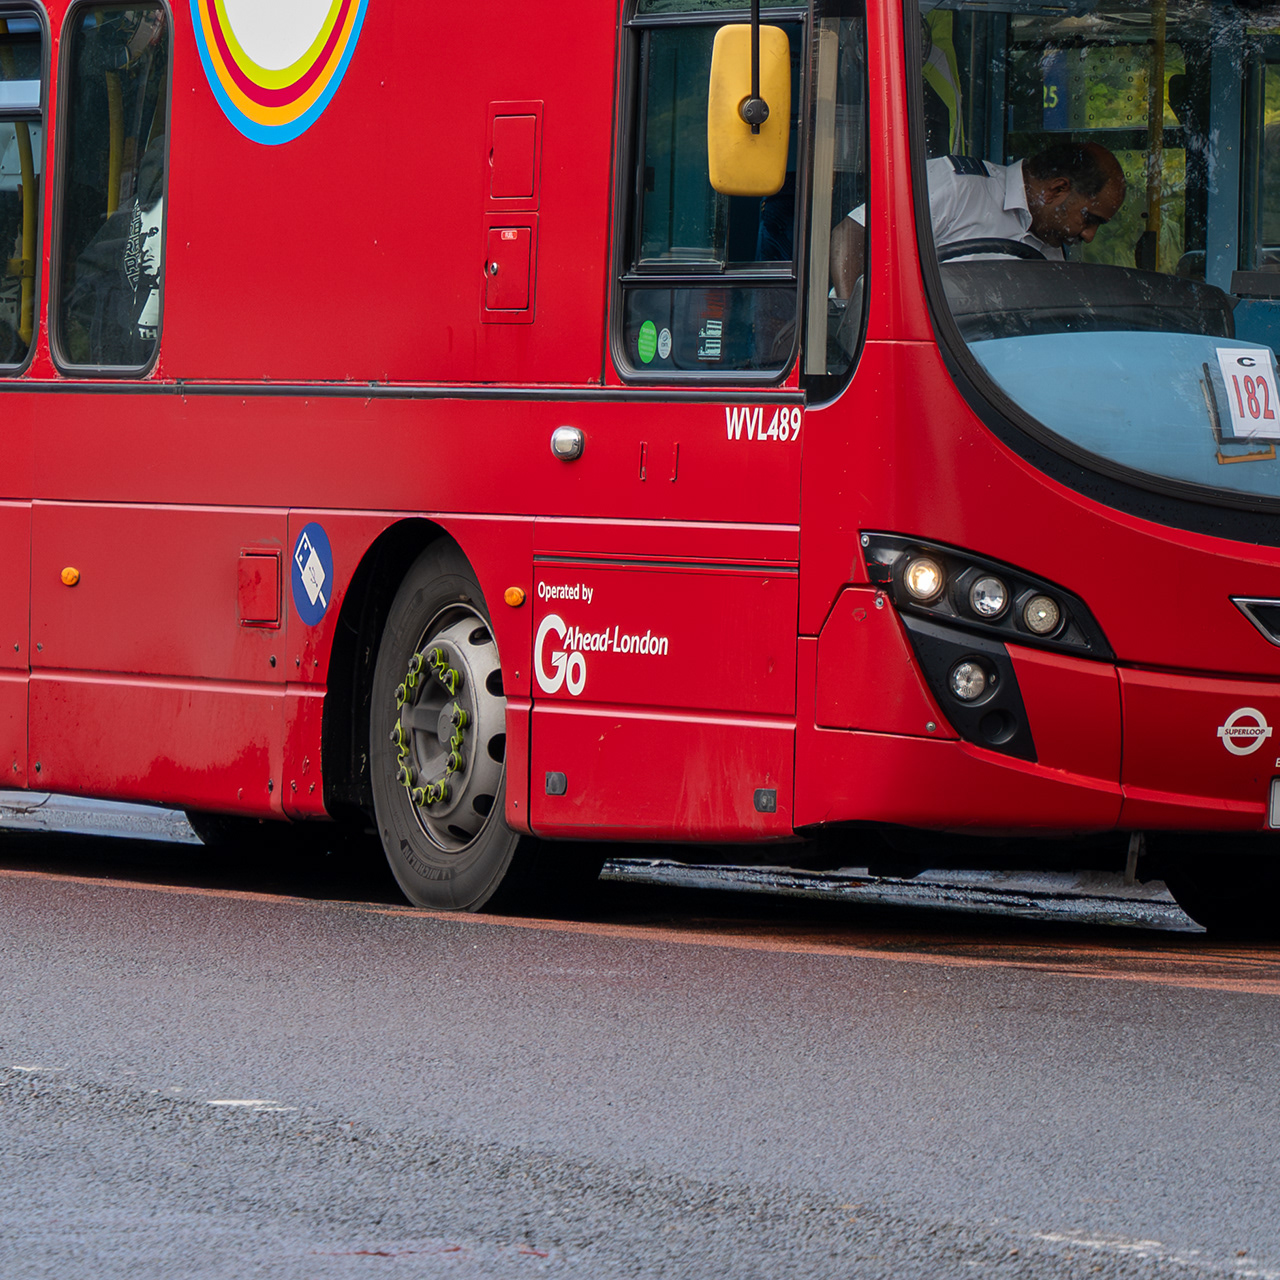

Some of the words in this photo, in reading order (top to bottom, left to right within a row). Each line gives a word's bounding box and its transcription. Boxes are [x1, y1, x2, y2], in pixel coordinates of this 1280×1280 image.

[1237, 357, 1256, 367] C
[1232, 375, 1275, 419] 182
[725, 407, 801, 442] WVL489
[538, 581, 579, 602] Operated
[582, 583, 593, 604] by
[534, 614, 587, 696] Go
[563, 625, 669, 656] Ahead-London
[1225, 728, 1266, 736] SUPERLOOP
